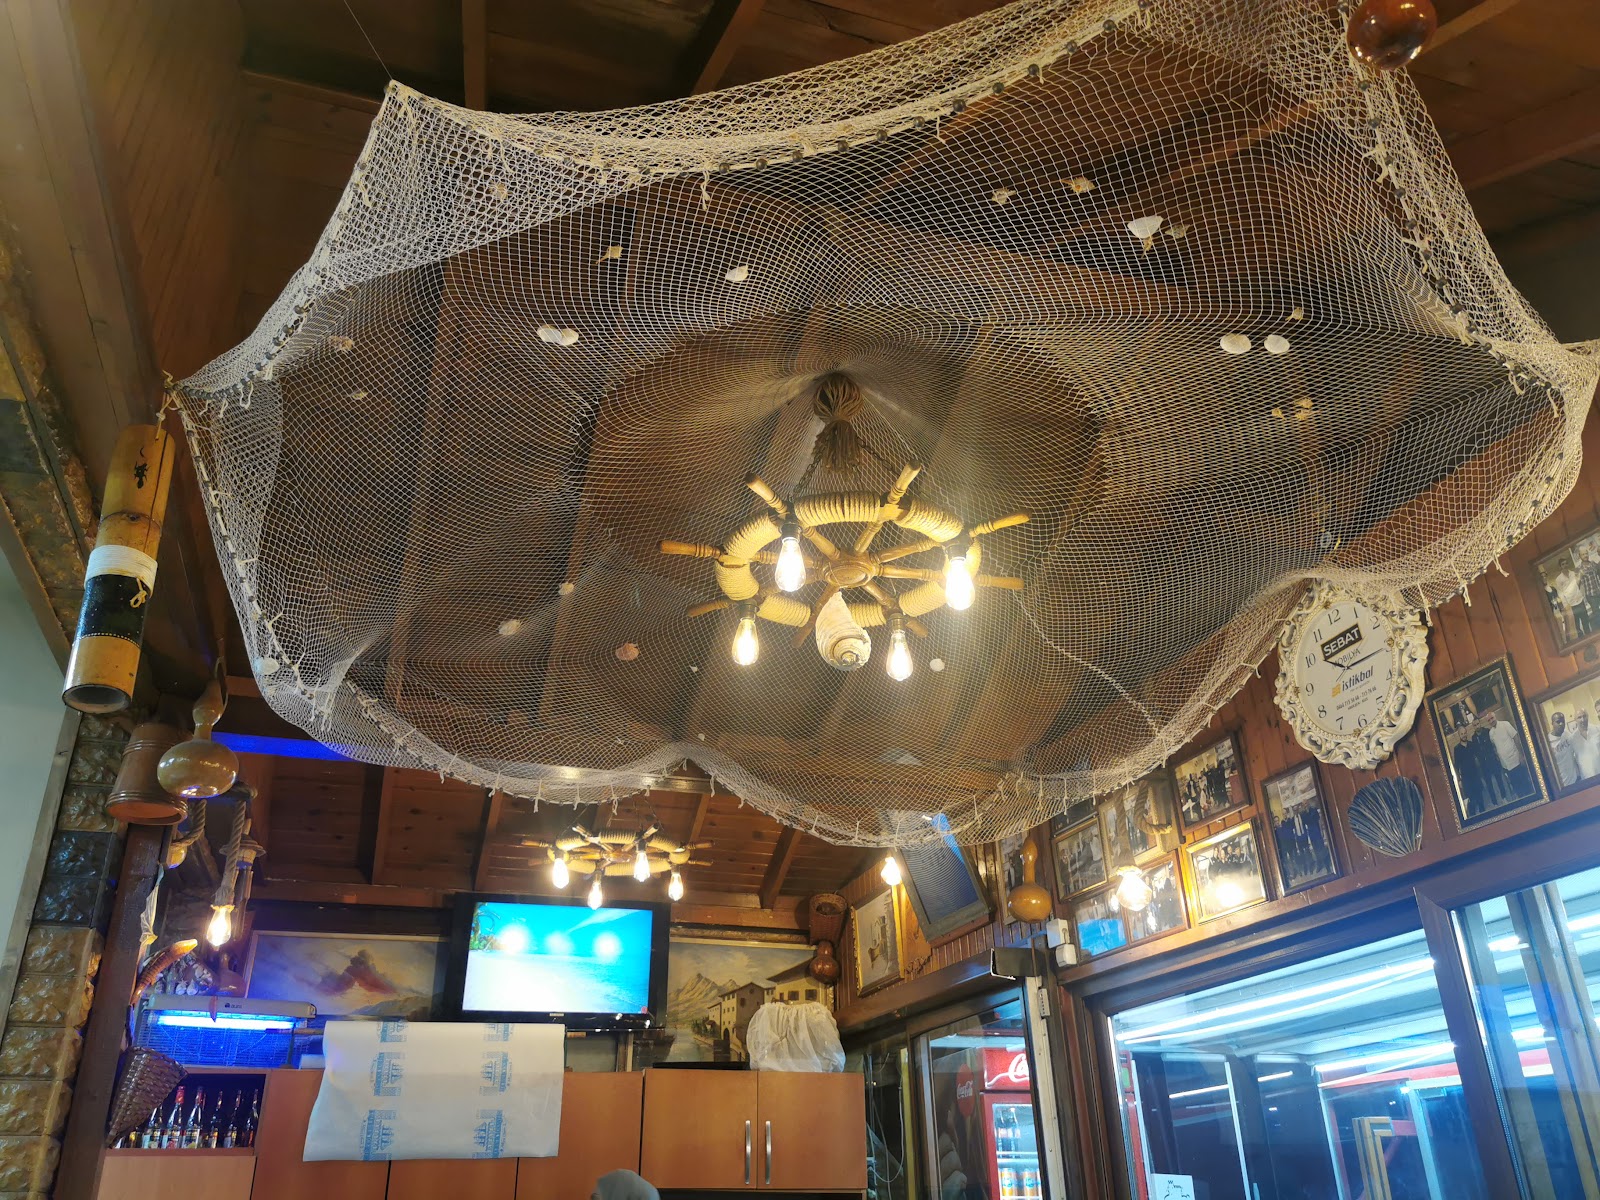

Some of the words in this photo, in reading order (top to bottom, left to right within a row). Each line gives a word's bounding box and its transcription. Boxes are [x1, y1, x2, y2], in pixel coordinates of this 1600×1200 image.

[1327, 608, 1341, 626] 12
[1369, 615, 1381, 630] 2
[1313, 628, 1323, 643] 11
[1323, 627, 1360, 657] SEBAT
[1305, 652, 1317, 669] 10
[1341, 665, 1374, 692] istikbal
[1305, 682, 1315, 697] 9
[1317, 704, 1327, 719] 8
[1375, 695, 1385, 712] 5
[1335, 715, 1344, 731] 7
[1357, 713, 1368, 728] 6
